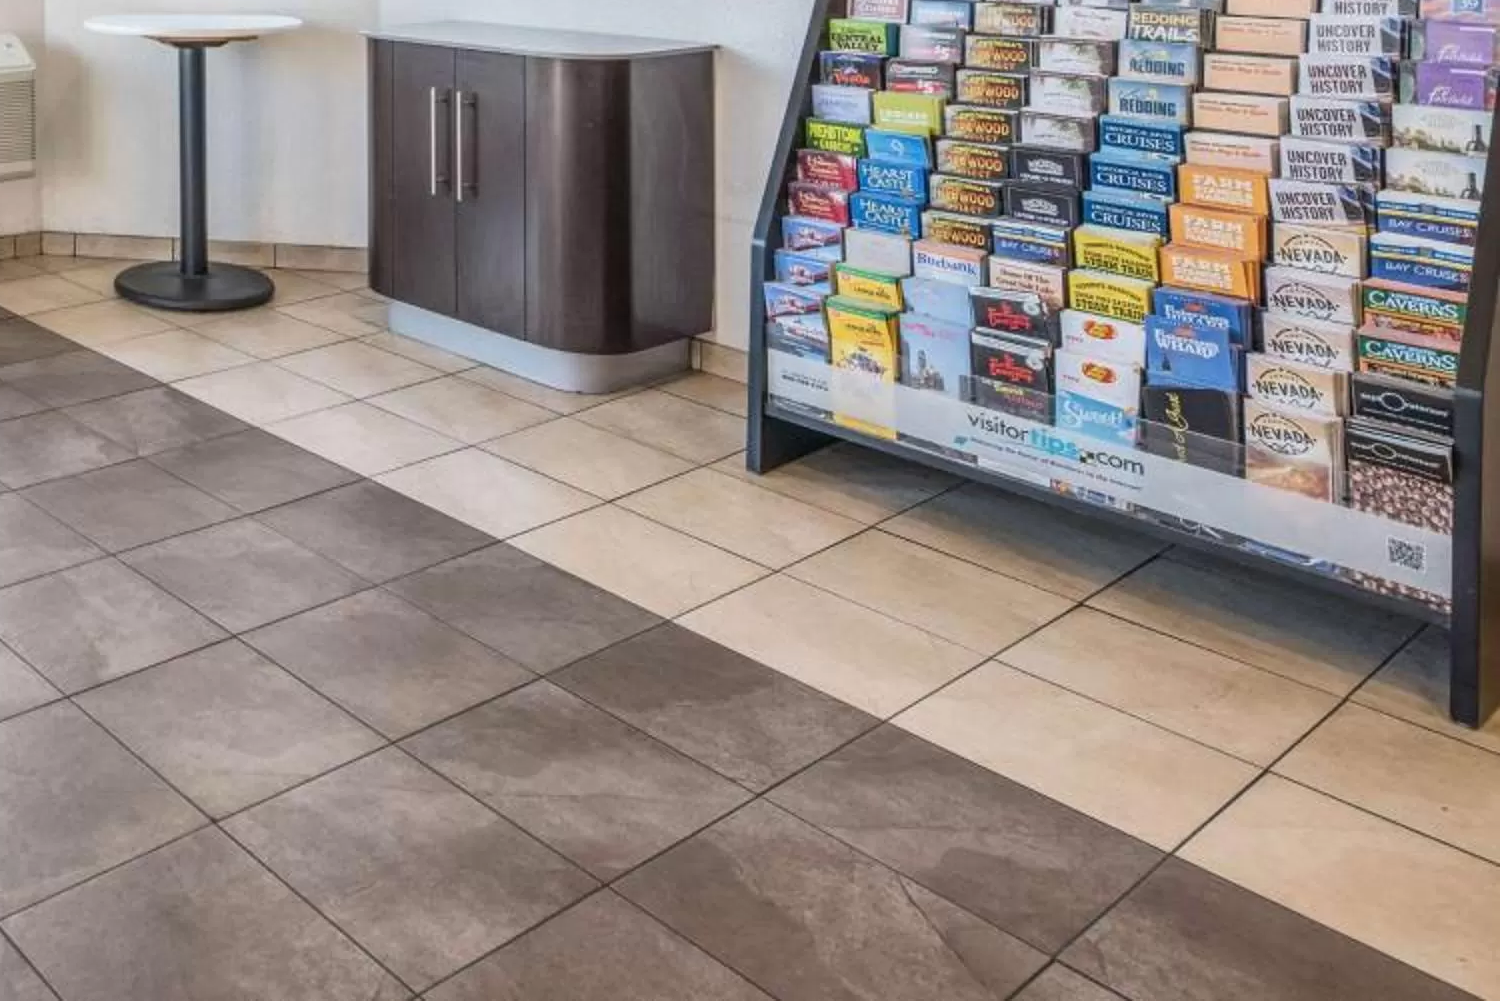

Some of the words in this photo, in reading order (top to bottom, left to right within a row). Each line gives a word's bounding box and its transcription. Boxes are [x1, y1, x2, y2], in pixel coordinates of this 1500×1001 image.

[1334, 1, 1388, 15] HISTORY
[1131, 12, 1198, 29] REDDING
[1130, 25, 1198, 42] TRAILS
[1316, 24, 1375, 38] UNCOVER
[837, 41, 880, 52] VALLEY
[1317, 38, 1371, 52] HISTORY
[1129, 59, 1185, 77] REDDING
[1307, 64, 1367, 79] UNCOVER
[1311, 79, 1364, 94] HISTORY
[1119, 98, 1176, 117] REDDING
[1296, 107, 1356, 123] UNCOVER
[1300, 122, 1354, 137] HISTORY
[1105, 132, 1174, 152] CRUISES
[1287, 150, 1347, 166] UNCOVER
[862, 164, 913, 180] HEARST
[1289, 165, 1344, 181] HISTORY
[868, 177, 913, 192] CASTLE
[1096, 172, 1167, 193] CRUISES
[1276, 191, 1336, 206] UNCOVER
[860, 198, 912, 217] HEARST
[1279, 206, 1335, 221] HISTORY
[865, 209, 911, 228] CASTLE
[1091, 213, 1160, 233] CRUISES
[1388, 218, 1413, 229] BAY
[1416, 222, 1473, 238] CRUISES
[916, 252, 977, 275] Burbank
[1280, 247, 1344, 264] NEVADA
[1385, 261, 1409, 272] BAY
[1413, 265, 1470, 284] CRUISES
[1272, 294, 1337, 311] NEVADA
[1368, 290, 1458, 318] CAVERNS
[1271, 338, 1337, 360] NEVADA
[1365, 341, 1457, 370] CAVERNS
[1255, 377, 1322, 399] NEVADA
[1250, 423, 1316, 446] NEVADA
